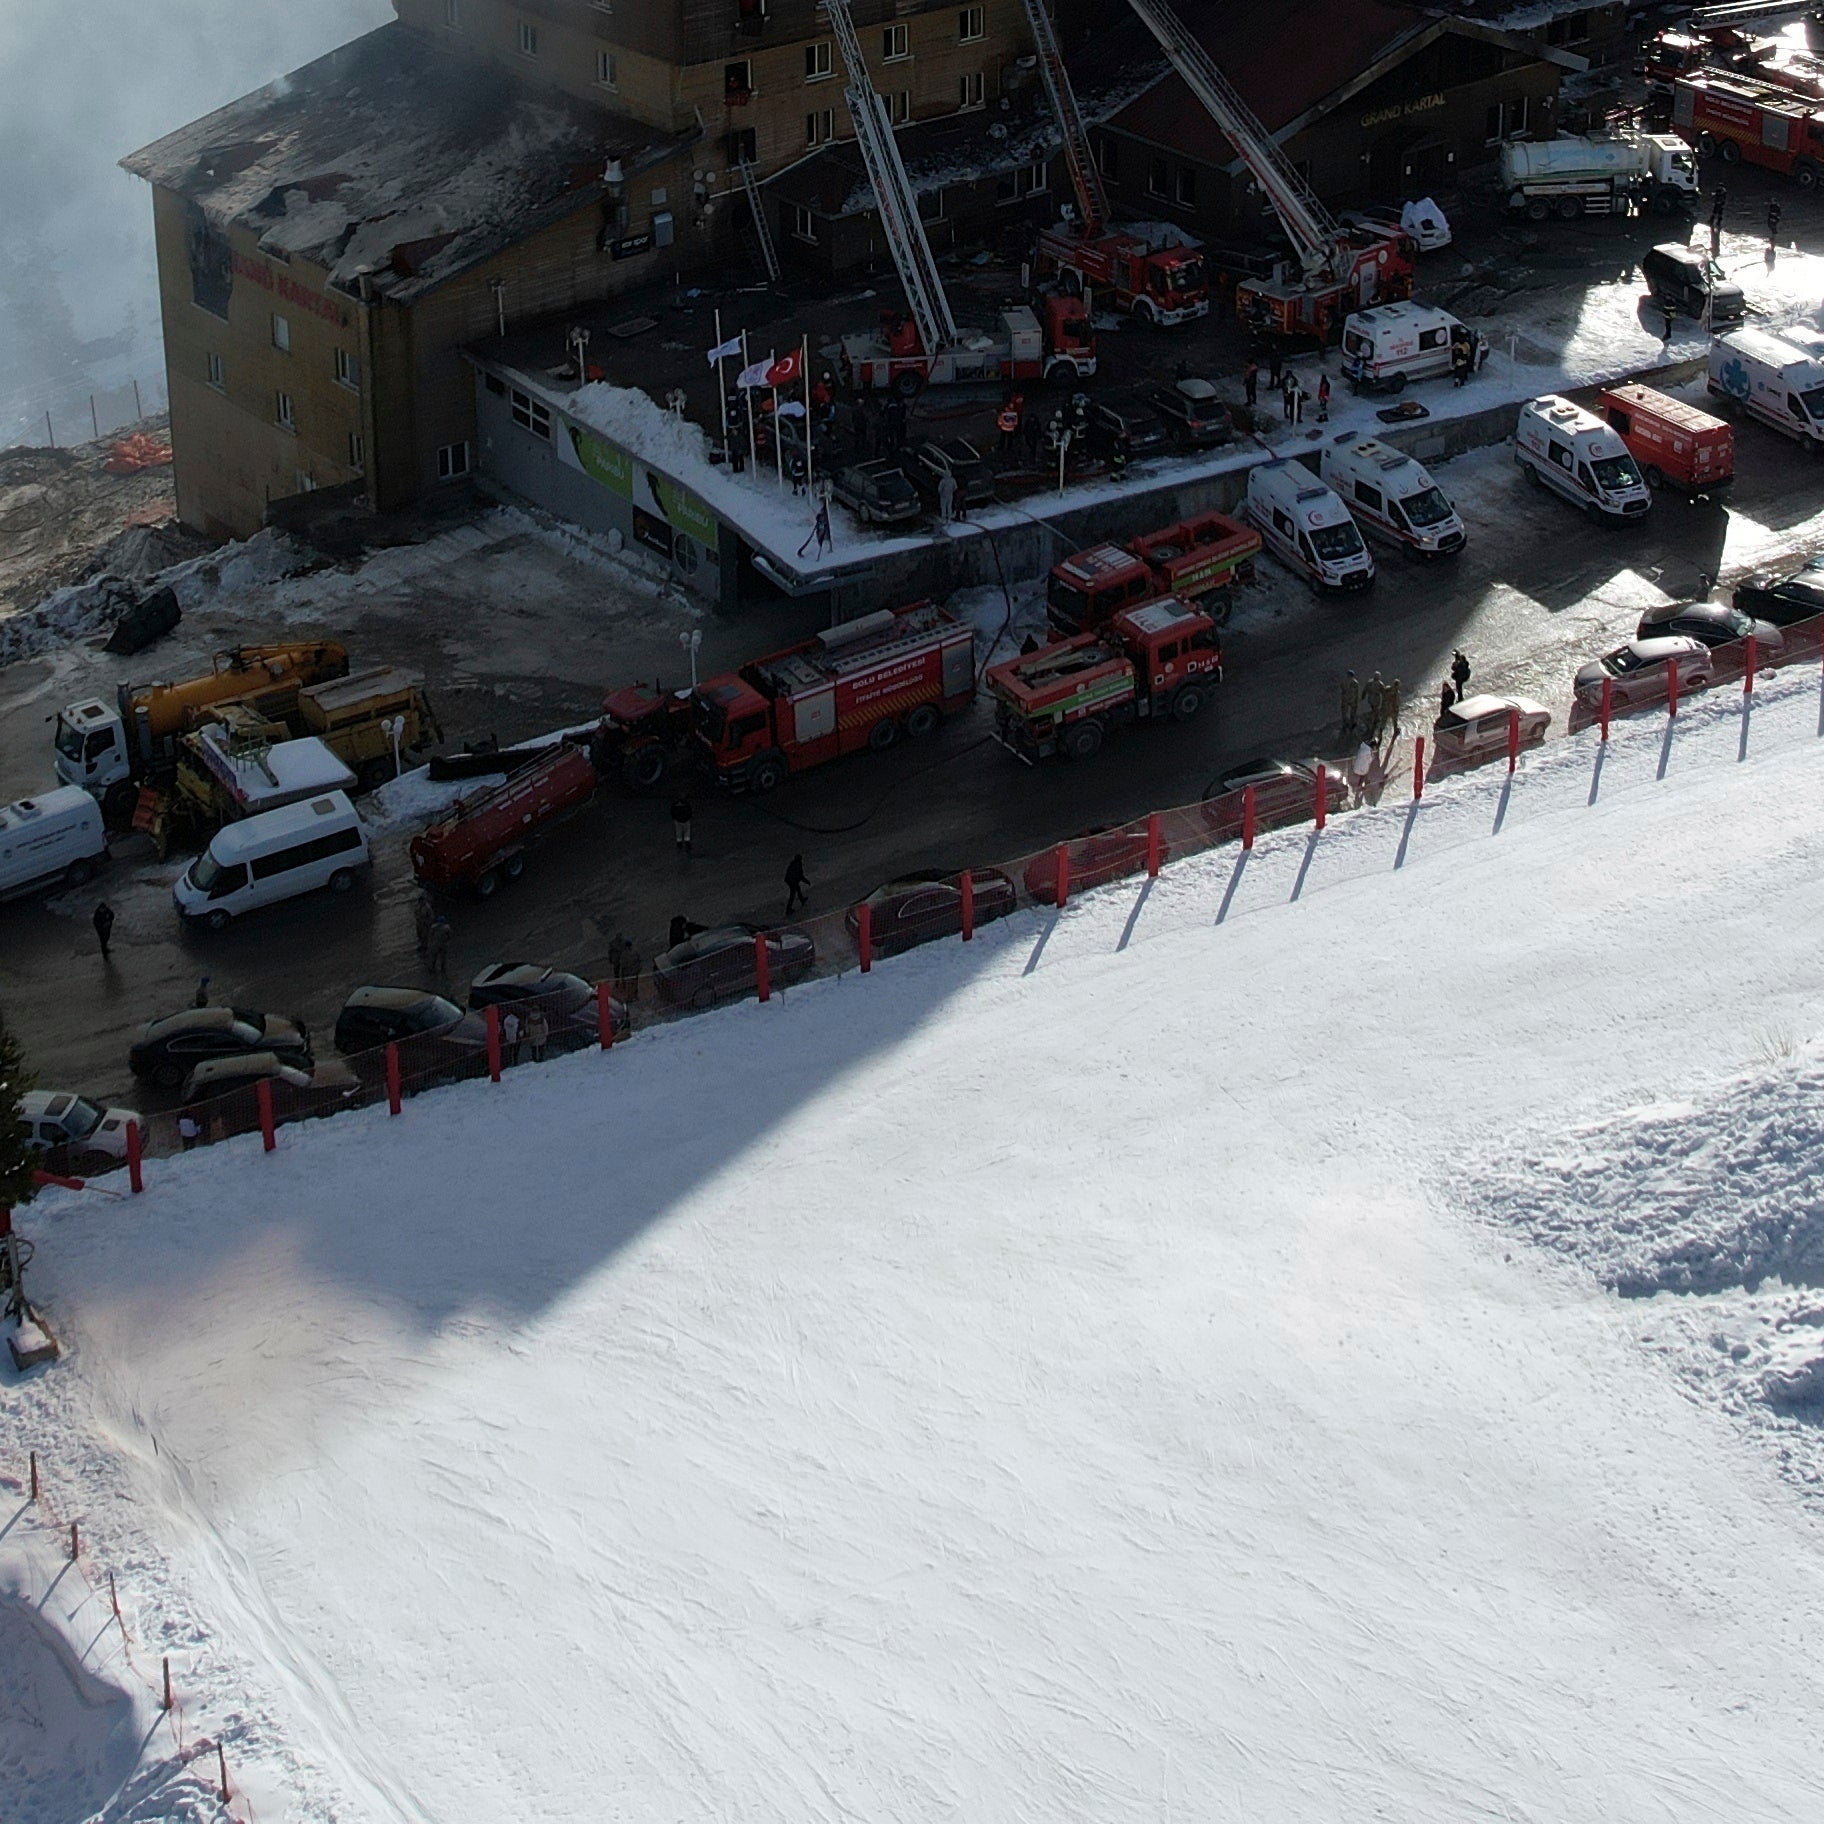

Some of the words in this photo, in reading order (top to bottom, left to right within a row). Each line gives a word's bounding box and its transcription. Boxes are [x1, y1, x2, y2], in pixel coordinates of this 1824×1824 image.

[1360, 105, 1402, 128] GRAND
[1403, 91, 1447, 115] KARTAL
[852, 676, 876, 690] BOLU
